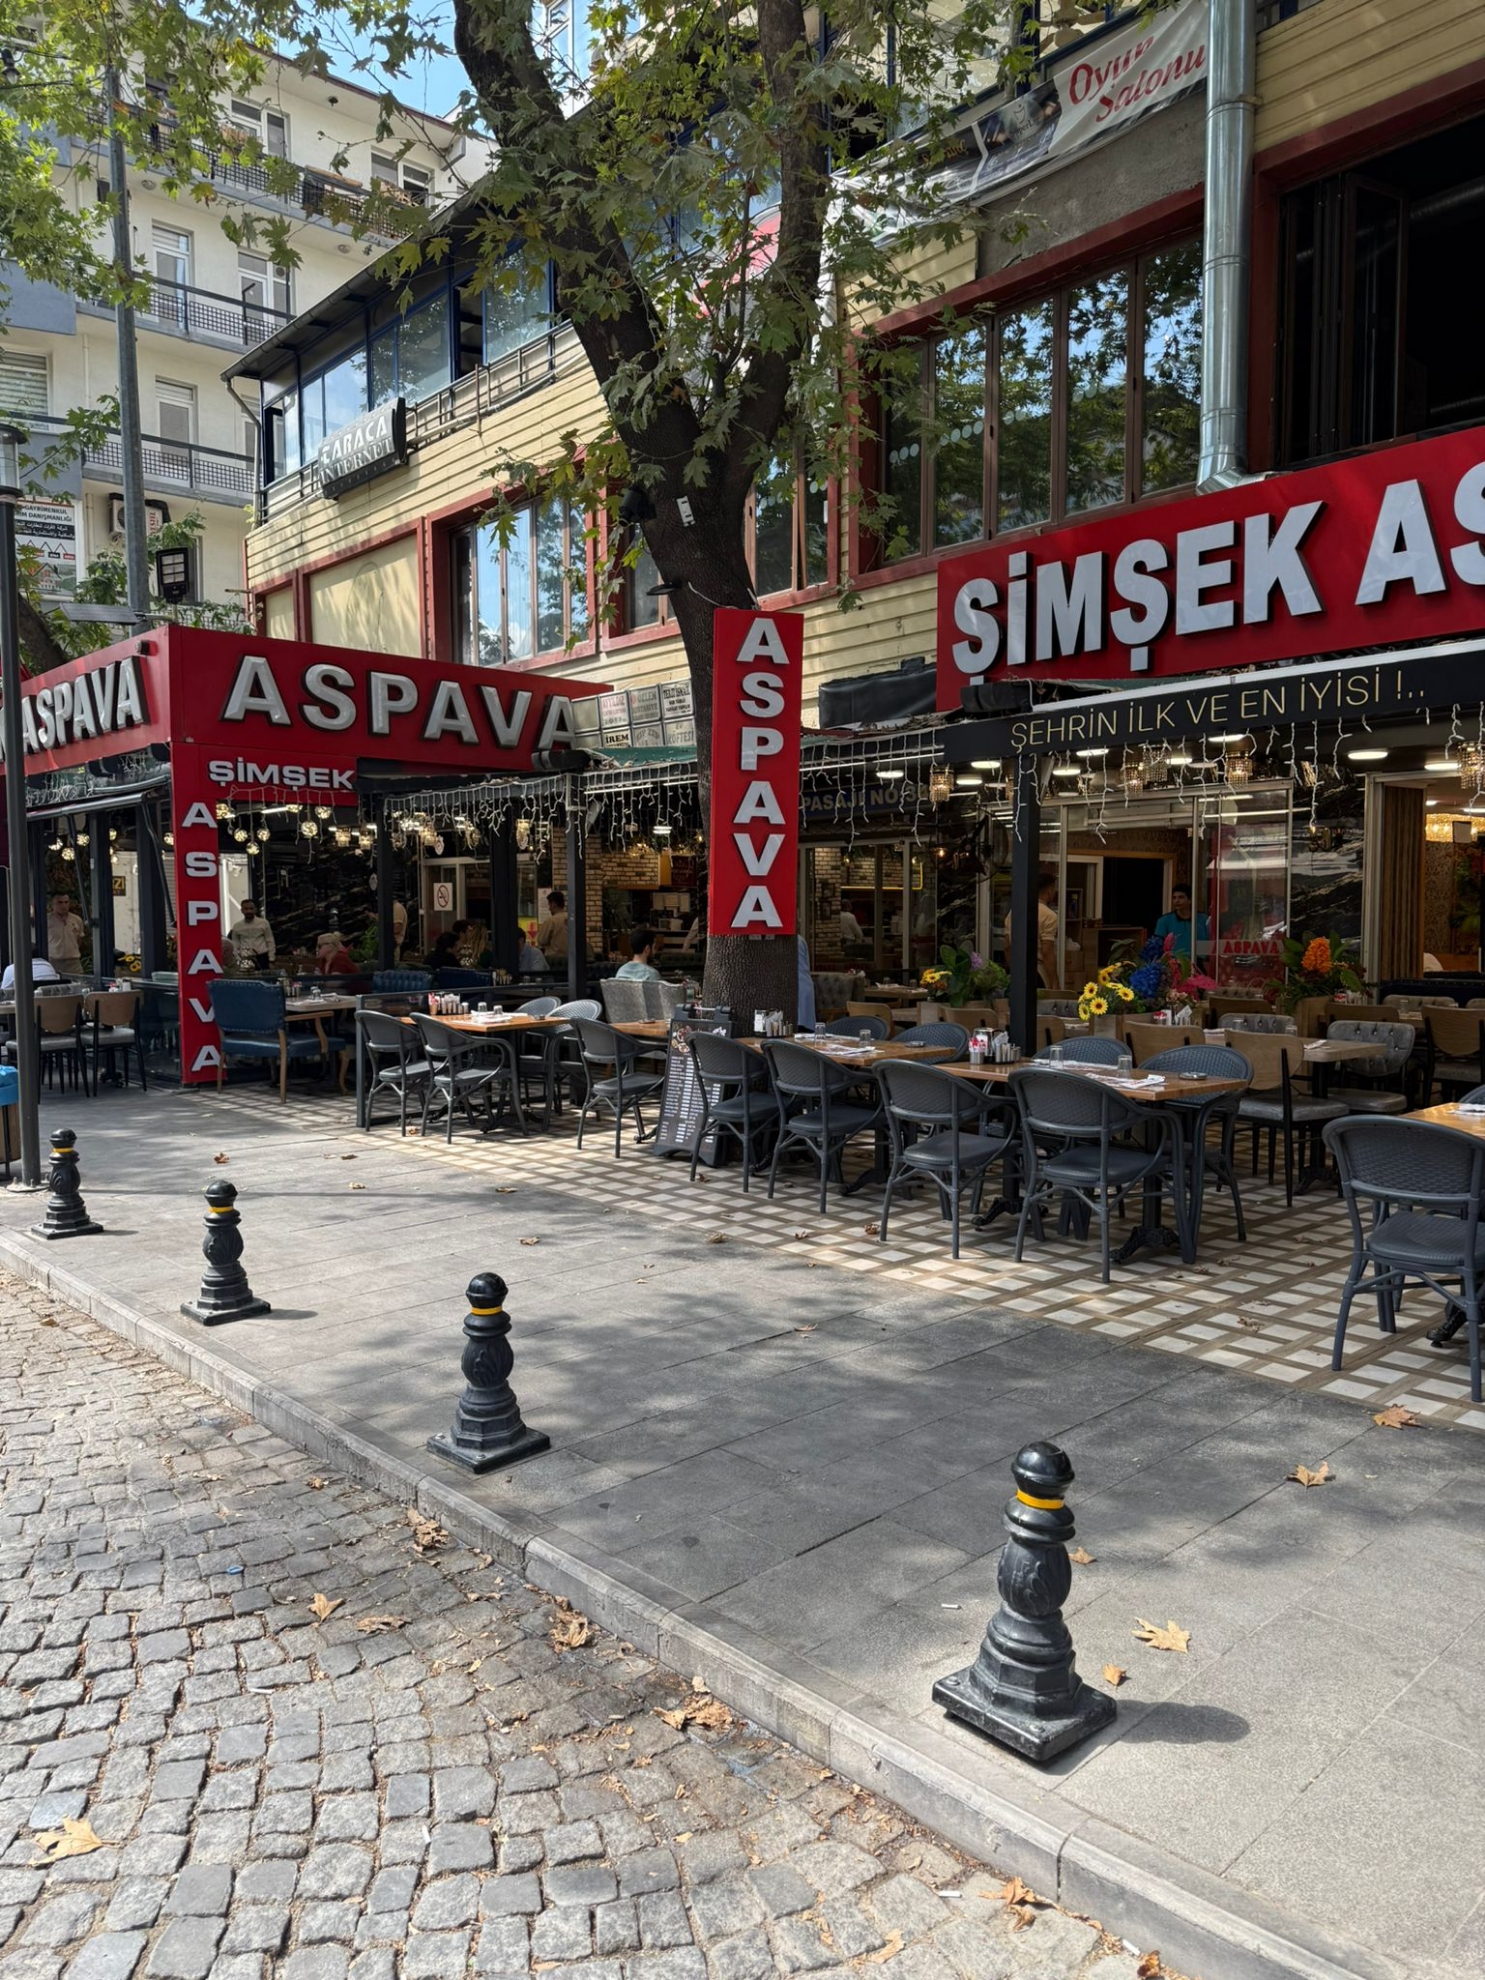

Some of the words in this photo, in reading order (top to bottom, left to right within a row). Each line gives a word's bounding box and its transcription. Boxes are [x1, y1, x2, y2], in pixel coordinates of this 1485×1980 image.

[1096, 45, 1206, 122] Salonu
[320, 437, 395, 485] INTERNET
[951, 500, 1325, 686] ŞİMŞEK
[22, 655, 147, 755] ASPAVA
[223, 655, 576, 750] ASPAVA
[605, 733, 630, 744] İREM
[1010, 709, 1117, 754] ŞEHRİN
[1128, 701, 1176, 733] İLK
[1187, 693, 1229, 725] VE
[1240, 686, 1285, 719] EN
[1300, 666, 1380, 712] İYİSİ
[208, 757, 356, 791] ŞİMŞEK
[731, 617, 790, 928] ASPAVA
[182, 802, 223, 1072] ASPAVA
[1223, 940, 1279, 954] ASPAVA
